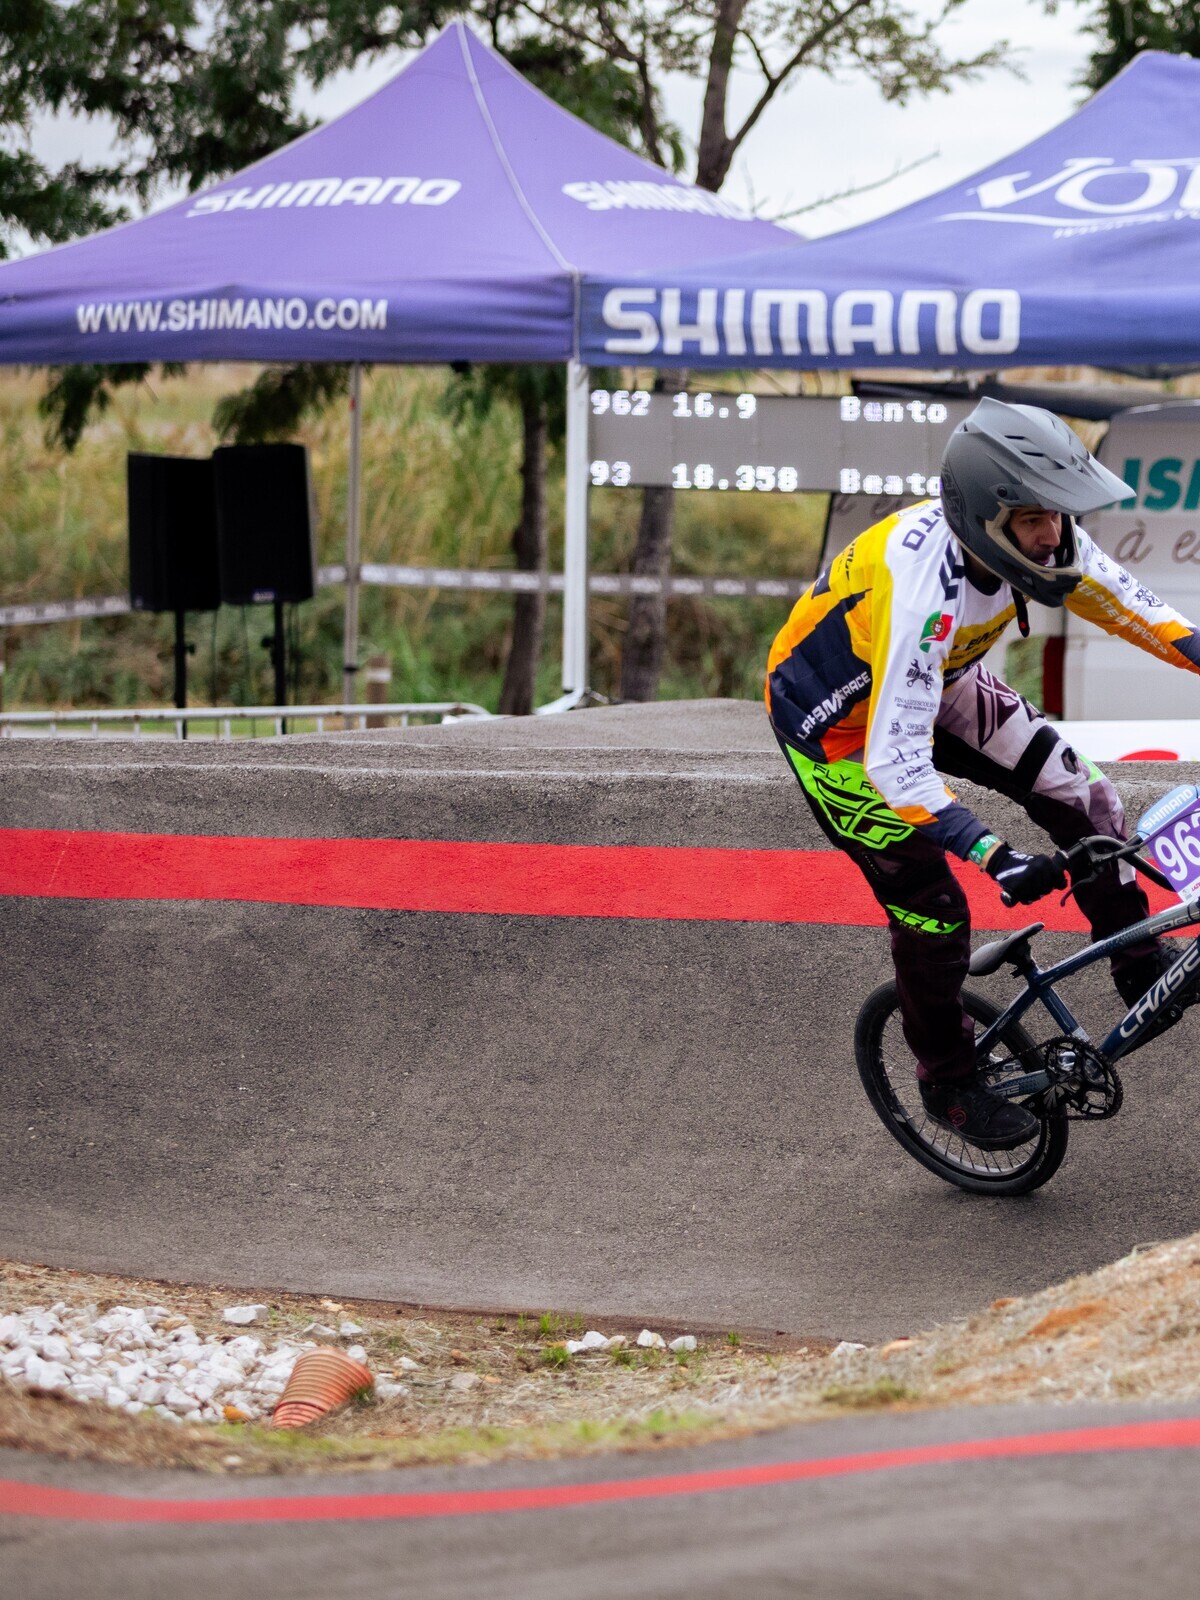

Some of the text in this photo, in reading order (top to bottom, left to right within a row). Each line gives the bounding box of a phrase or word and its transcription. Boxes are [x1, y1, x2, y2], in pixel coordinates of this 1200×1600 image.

[186, 176, 462, 218] SHIMANO
[76, 298, 388, 335] WWW.SHIMANO.COM
[602, 287, 1021, 356] SHIMANO
[591, 390, 947, 423] 962 16.9 Bento
[590, 461, 941, 496] 93 18.358 Beato
[813, 763, 852, 786] FLY
[1141, 788, 1194, 831] SHIMANO
